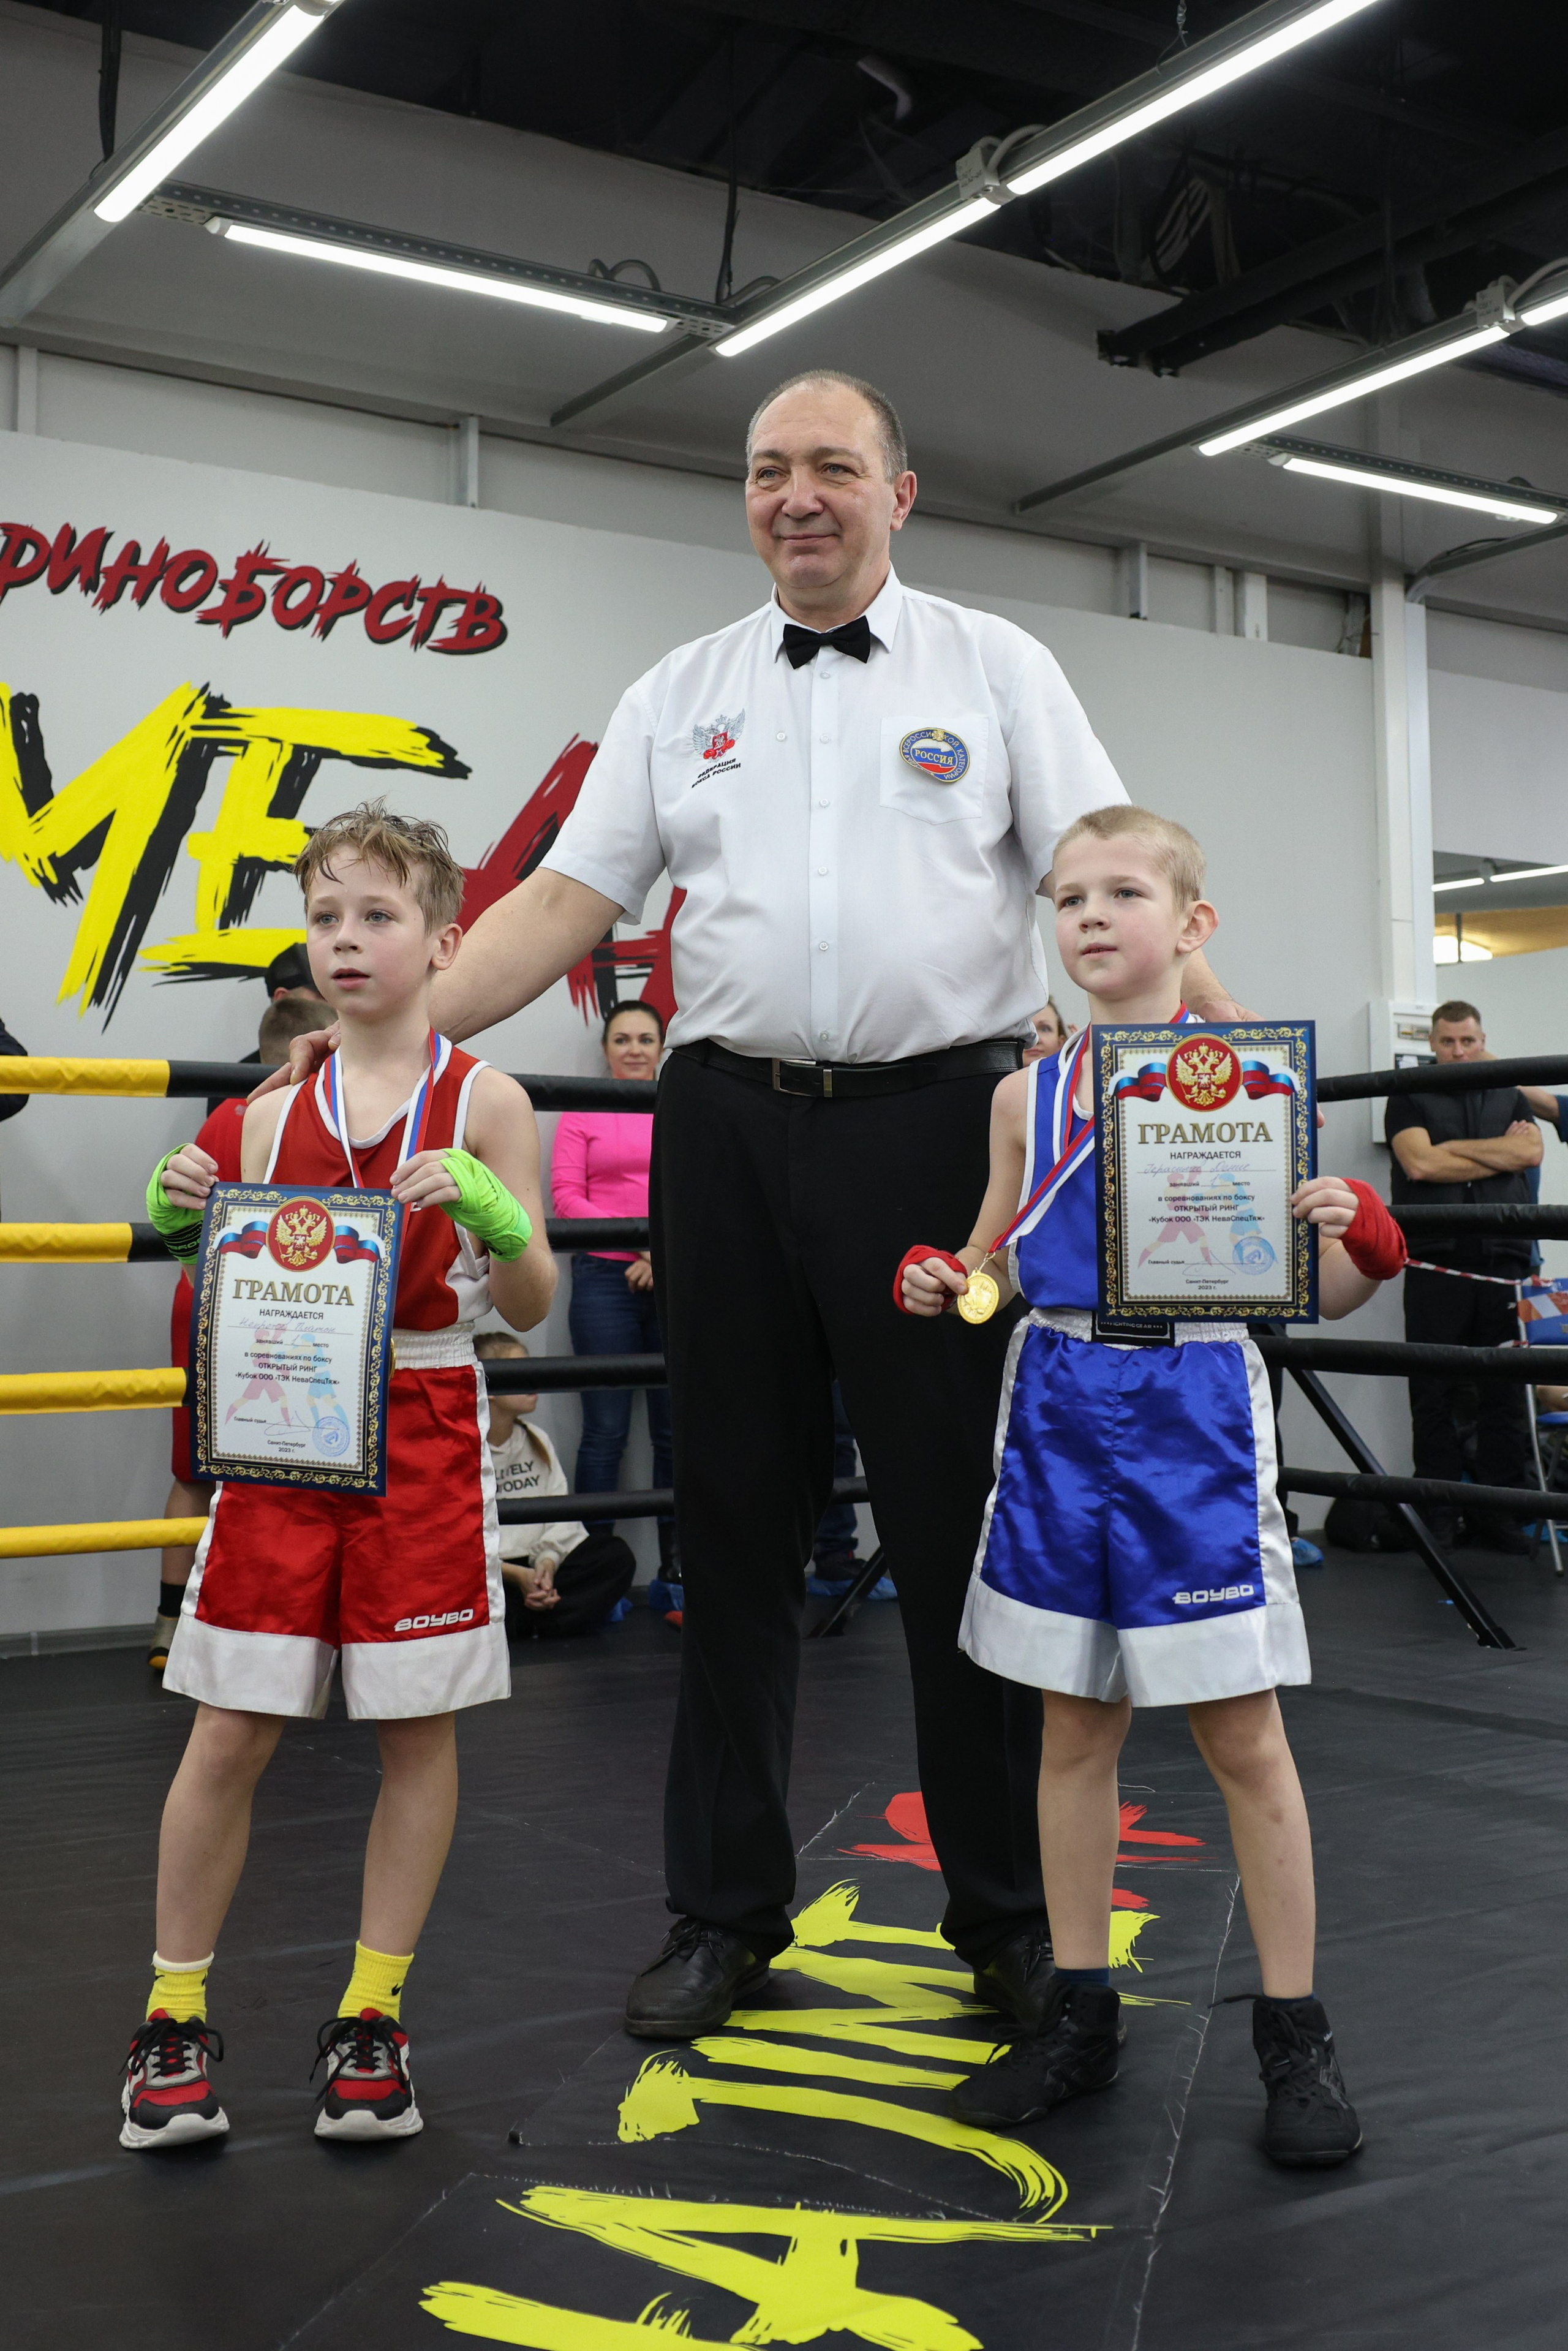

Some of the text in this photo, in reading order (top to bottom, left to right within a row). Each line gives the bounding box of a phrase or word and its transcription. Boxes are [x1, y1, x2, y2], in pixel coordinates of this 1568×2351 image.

[914, 749, 954, 766] РОССИЯ
[712, 763, 741, 776] РОССИИ
[1137, 1122, 1273, 1144] ГРАМОТА
[1170, 1150, 1241, 1160] НАГРАЖДАЕТСЯ
[1234, 1193, 1255, 1202] боксу
[232, 1278, 355, 1306] ГРАМОТА
[259, 1308, 323, 1319] НАГРАЖДАЕТСЯ
[250, 1353, 302, 1361] соревнованиях
[313, 1355, 333, 1364] боксу
[258, 1362, 298, 1371] ОТКРЫТЫЙ
[267, 1440, 306, 1448] Санкт-Петербург
[1172, 1584, 1254, 1604] BOYBO
[394, 1609, 474, 1632] BOYBO
